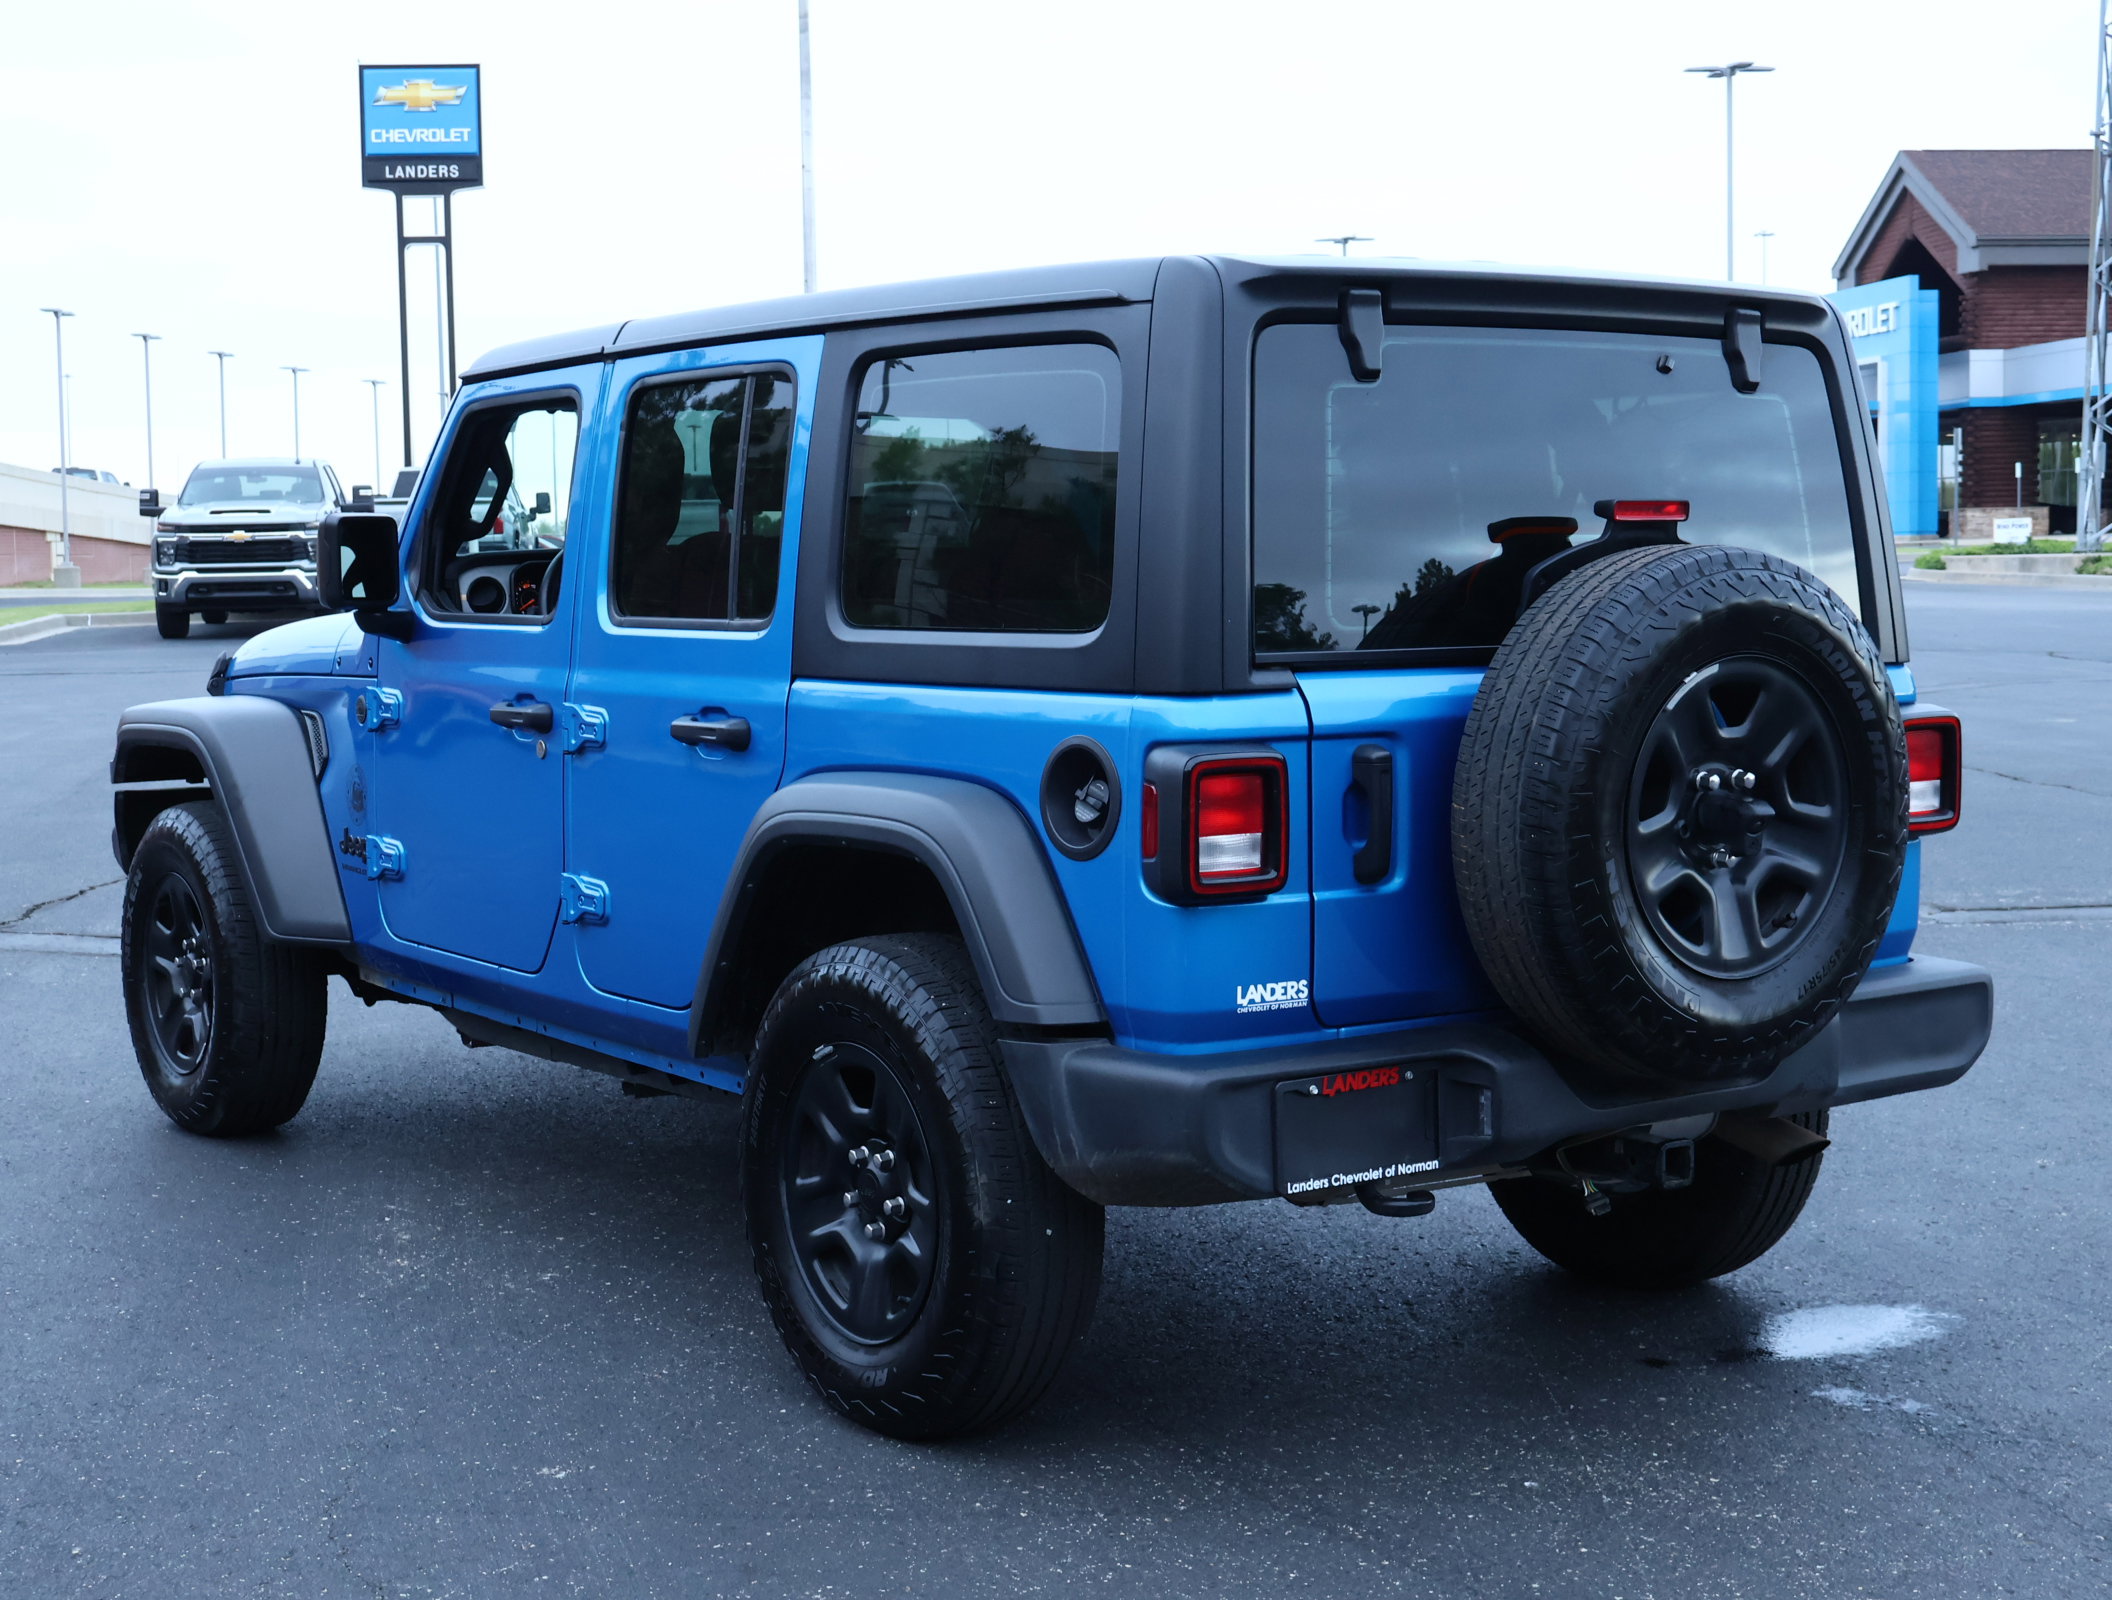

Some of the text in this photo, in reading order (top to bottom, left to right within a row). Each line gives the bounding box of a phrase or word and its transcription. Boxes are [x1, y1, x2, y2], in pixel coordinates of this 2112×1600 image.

[370, 127, 471, 143] CHEVROLET
[385, 164, 460, 179] LANDERS
[1844, 301, 1900, 338] ROLET
[1236, 978, 1309, 1007] LANDERS
[1236, 1004, 1270, 1014] CHEVROLET
[1280, 1001, 1308, 1010] NORMAN
[1322, 1066, 1400, 1097] LANDERS
[1287, 1159, 1439, 1194] Landers Chevrolet of Norman
